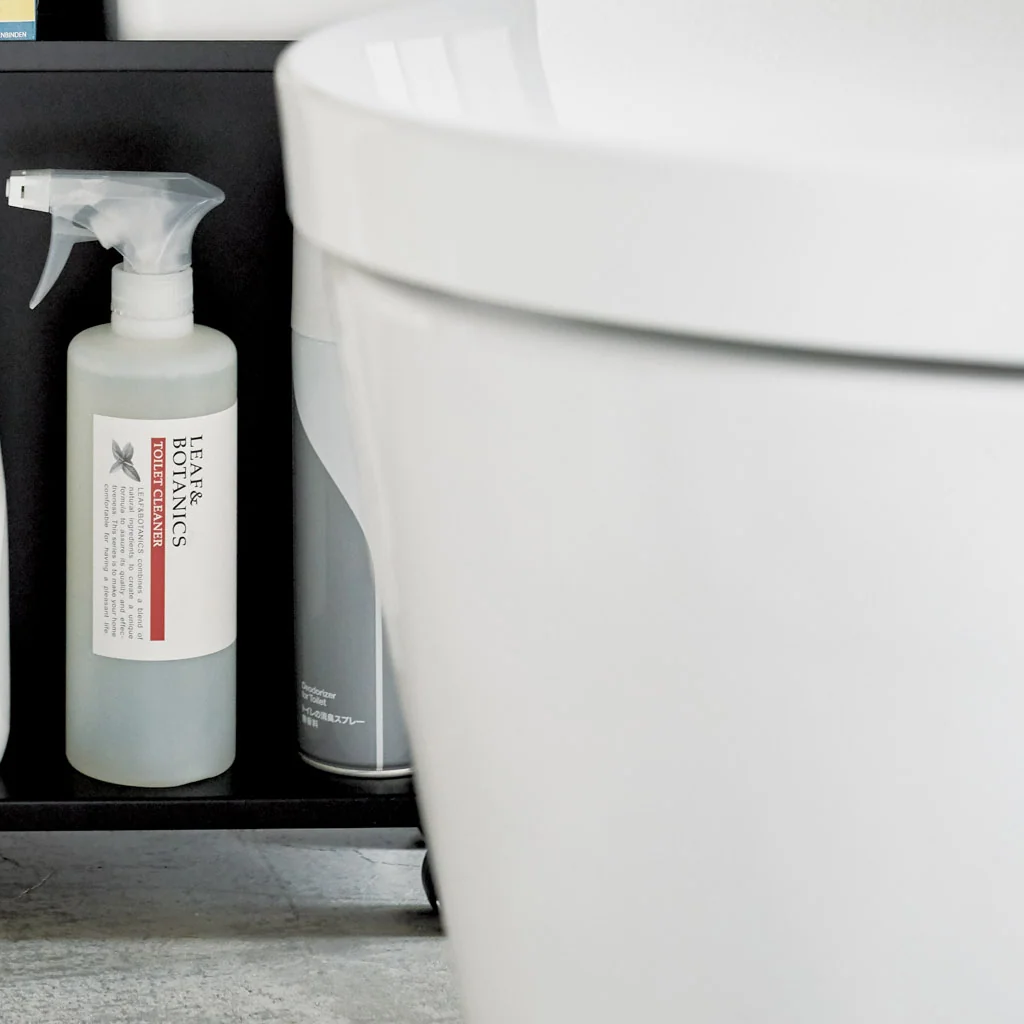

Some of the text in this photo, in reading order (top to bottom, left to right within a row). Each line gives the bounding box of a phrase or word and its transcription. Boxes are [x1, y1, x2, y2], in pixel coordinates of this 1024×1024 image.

[153, 441, 164, 547] TOILET CLEANER
[172, 436, 187, 547] BOTANICS
[189, 435, 203, 505] LEAF&
[127, 517, 135, 559] ingredients
[137, 632, 143, 640] of
